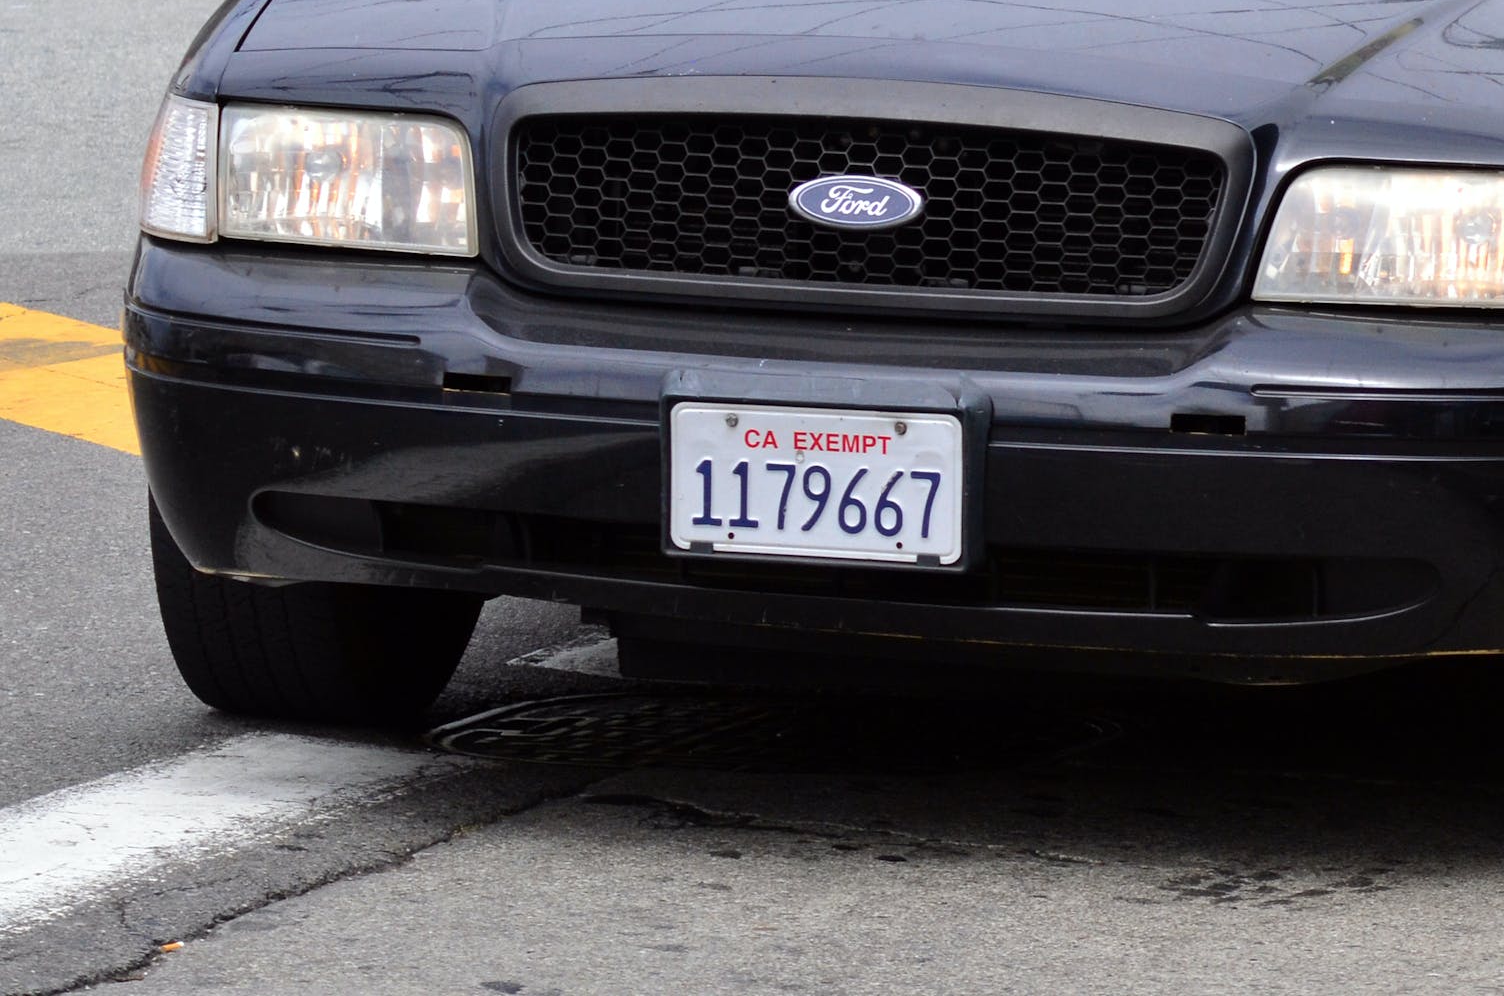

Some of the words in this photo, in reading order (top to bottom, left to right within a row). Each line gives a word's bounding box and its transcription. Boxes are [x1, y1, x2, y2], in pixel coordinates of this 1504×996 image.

[820, 185, 891, 217] Ford
[744, 429, 778, 449] CA
[793, 431, 892, 455] EXEMPT
[692, 459, 941, 539] 1179667
